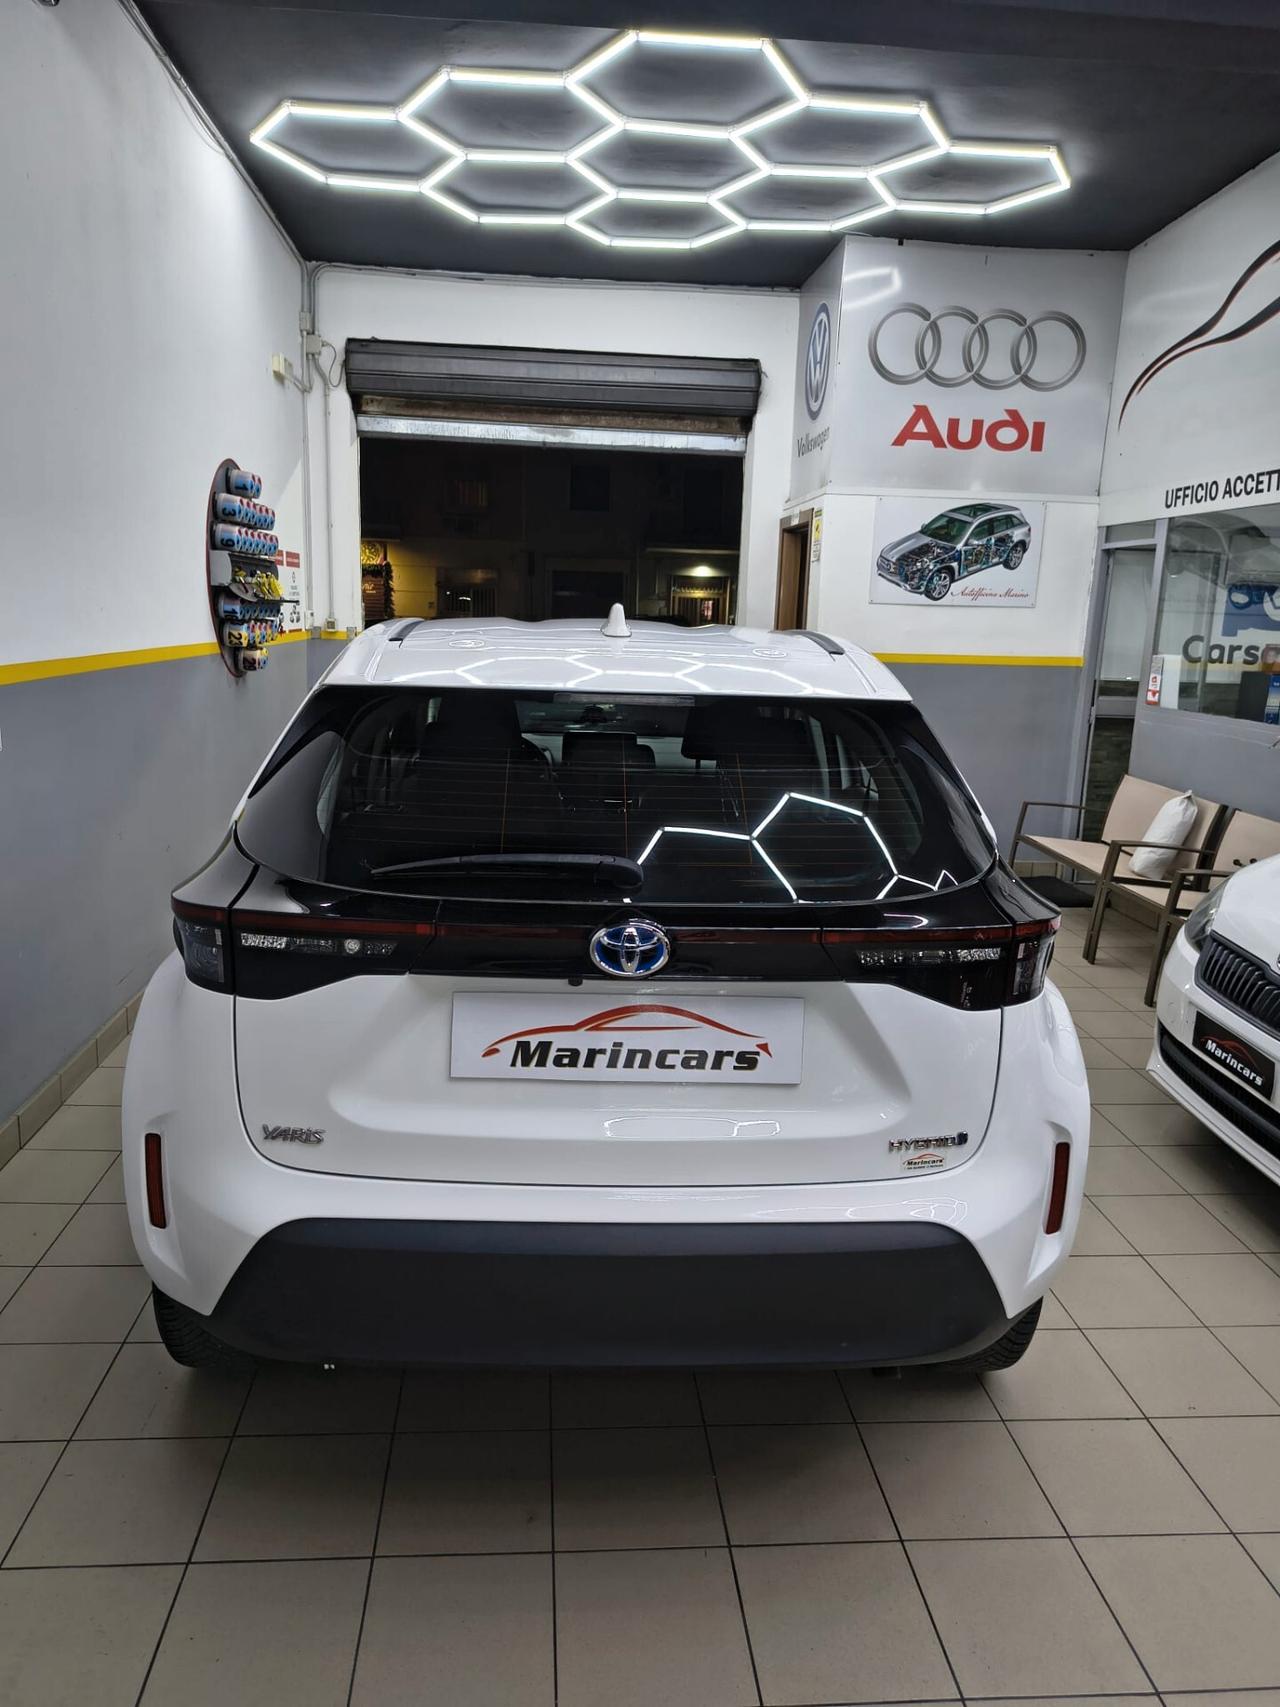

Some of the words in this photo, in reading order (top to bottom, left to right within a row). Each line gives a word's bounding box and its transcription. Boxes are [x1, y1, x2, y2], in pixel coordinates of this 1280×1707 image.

[891, 405, 1046, 452] Audi
[1165, 480, 1219, 509] UFFICIO
[1222, 468, 1280, 499] ACCETT
[1182, 635, 1266, 666] Cars
[510, 1040, 761, 1072] Marincars
[1205, 1039, 1264, 1087] Marincars
[262, 1123, 326, 1145] YARIS
